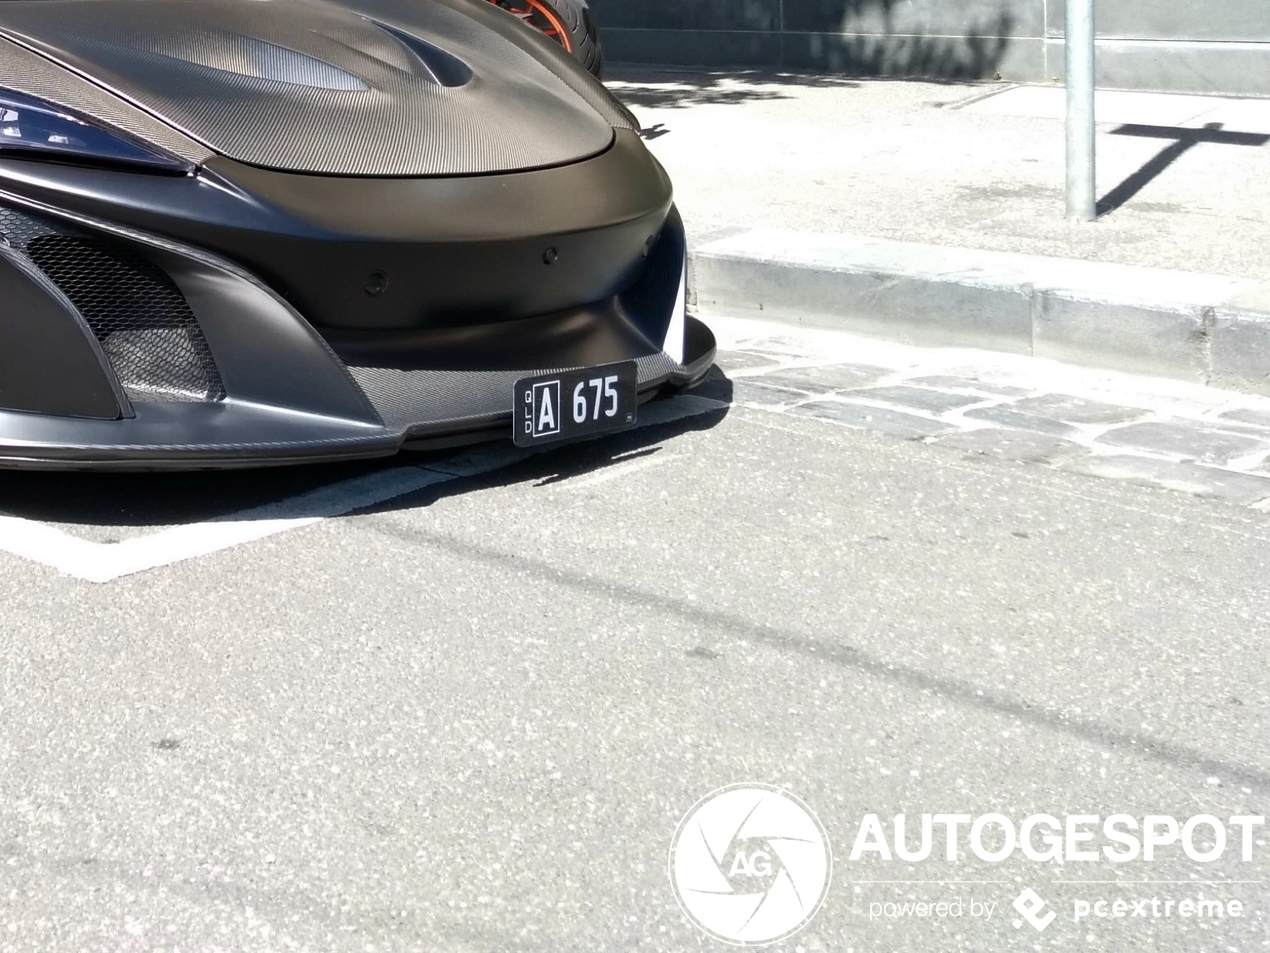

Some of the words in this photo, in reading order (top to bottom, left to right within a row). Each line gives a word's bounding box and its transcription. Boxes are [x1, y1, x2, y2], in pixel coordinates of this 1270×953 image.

[524, 390, 533, 434] QLD
[538, 387, 555, 431] A
[572, 375, 619, 424] 675
